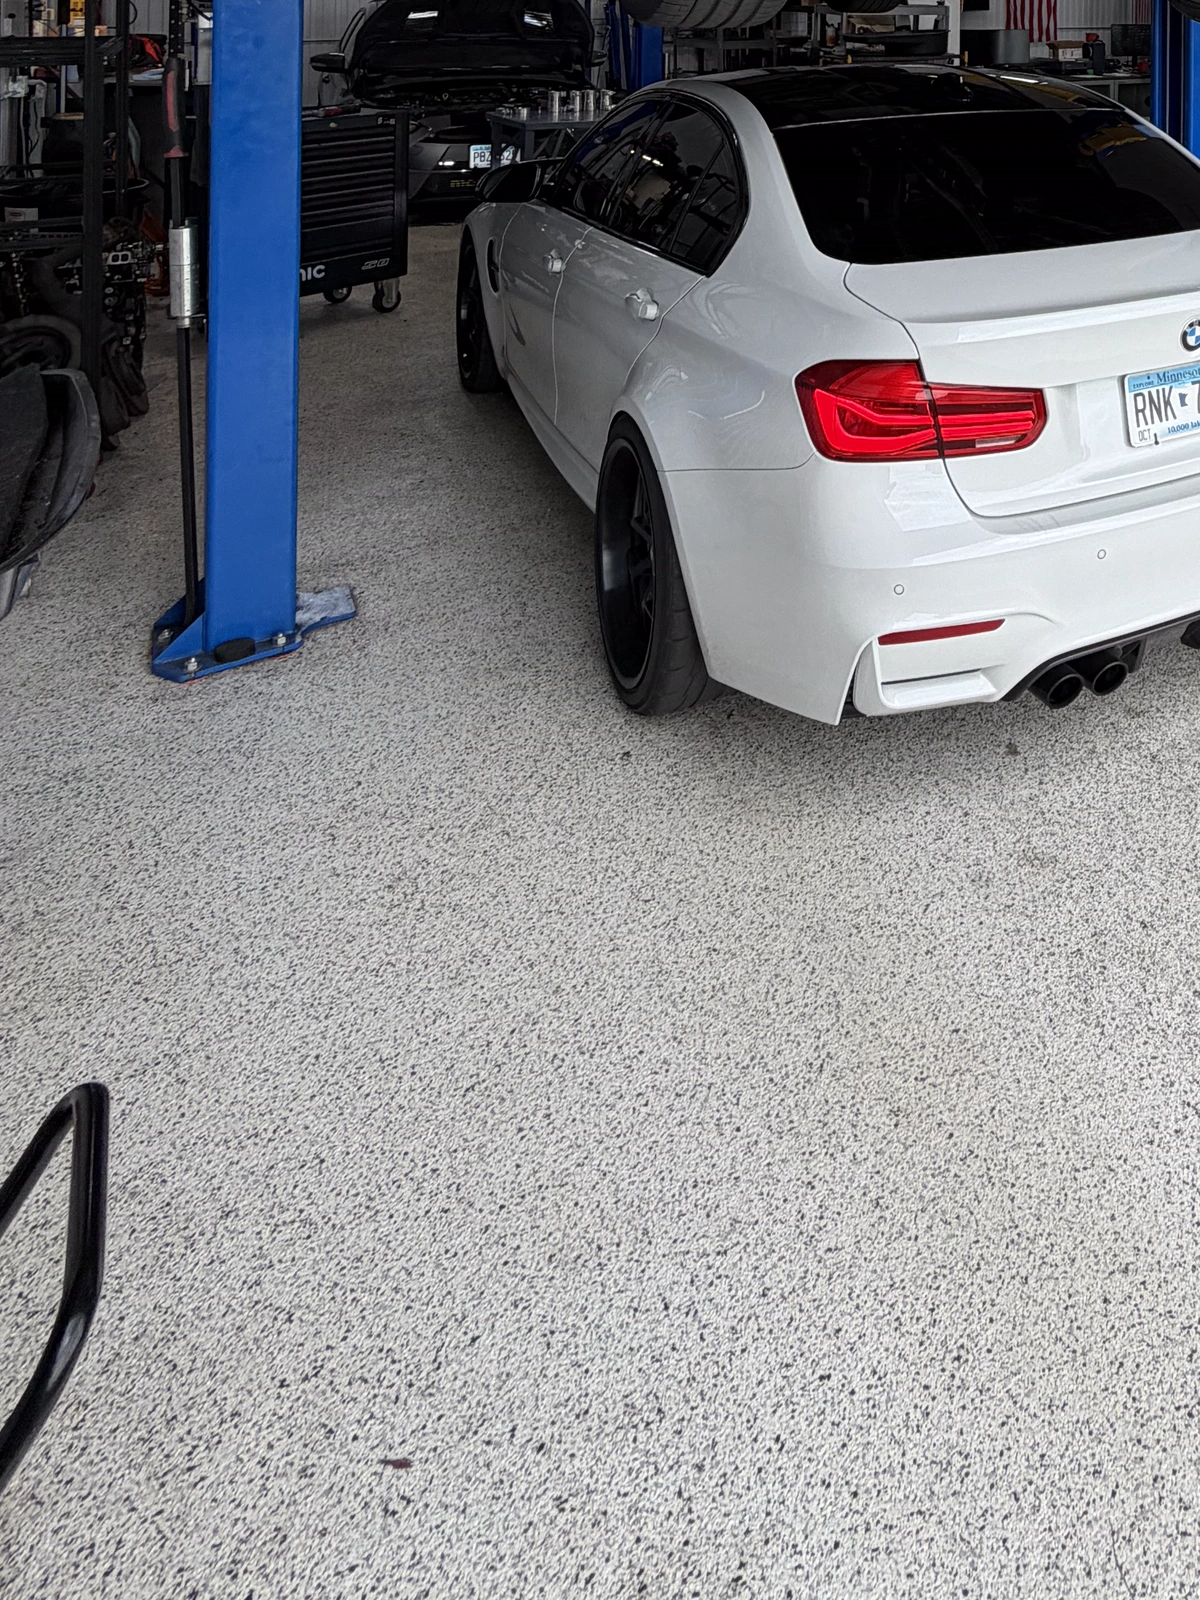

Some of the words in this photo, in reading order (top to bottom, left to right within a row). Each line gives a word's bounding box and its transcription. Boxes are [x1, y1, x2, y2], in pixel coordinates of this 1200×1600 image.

[1133, 385, 1178, 429] RNK
[1138, 427, 1152, 442] OCT
[1167, 421, 1190, 434] 10,000
